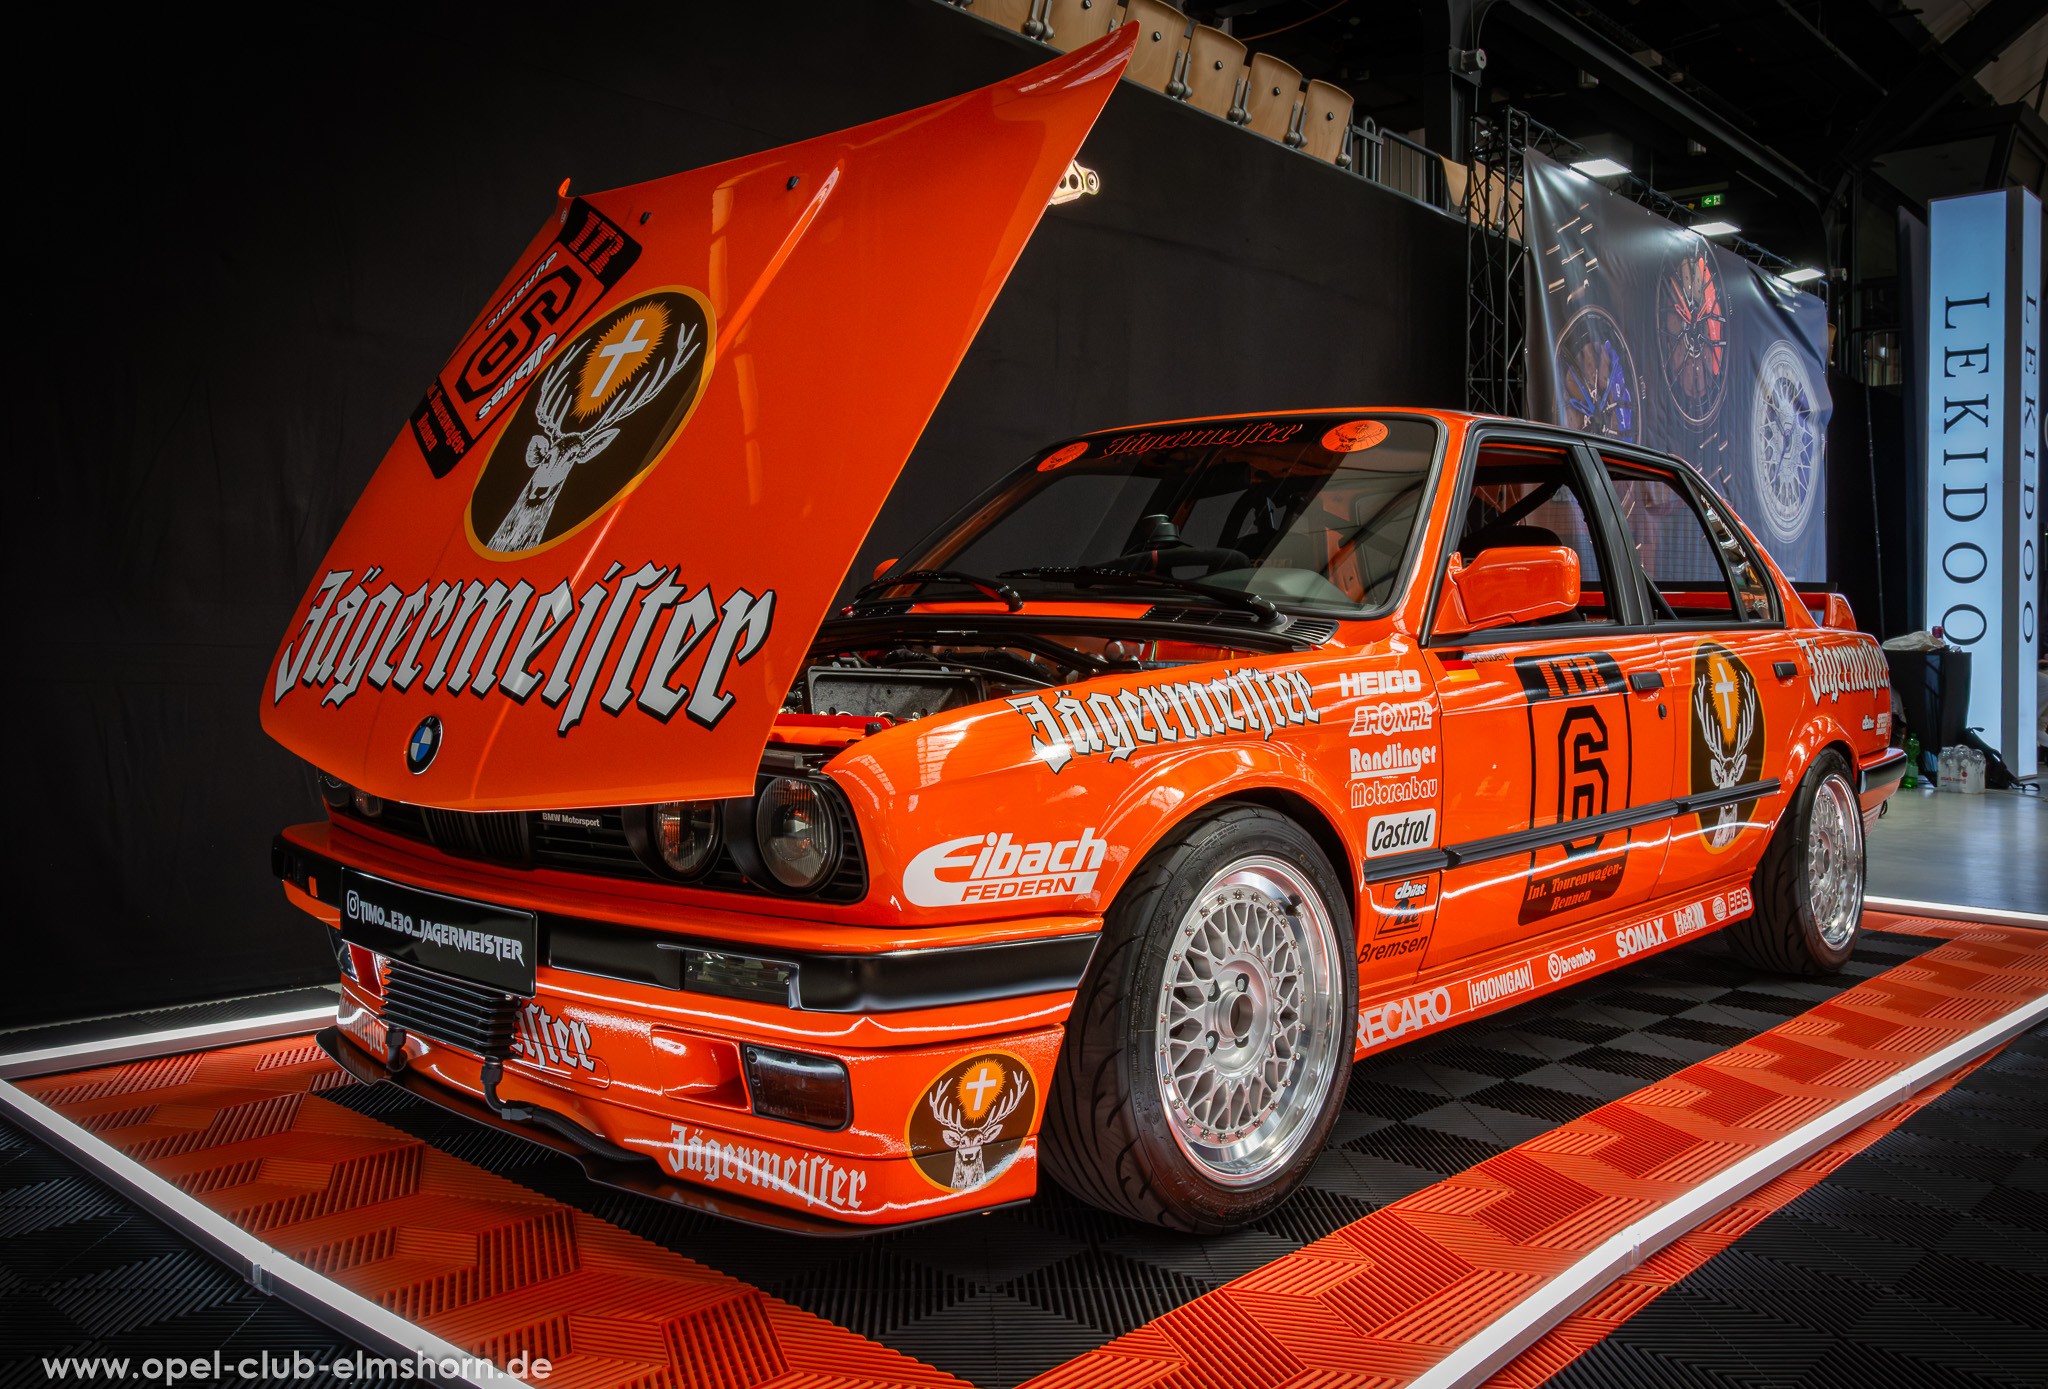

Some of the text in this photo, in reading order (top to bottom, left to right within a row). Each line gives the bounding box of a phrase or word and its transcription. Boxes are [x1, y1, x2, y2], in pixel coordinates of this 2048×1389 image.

[569, 210, 625, 276] ITR
[475, 333, 557, 421] dbilas
[1941, 292, 1991, 645] LEKIDOO
[2022, 290, 2037, 644] LEKIDOO
[274, 561, 777, 737] Jägermeister
[1339, 669, 1422, 697] HEIGO
[1535, 656, 1610, 698] ITR
[1005, 667, 1321, 774] Jägermeister
[1350, 742, 1437, 775] Randlinger
[1351, 775, 1438, 809] Motorenbau
[1558, 704, 1609, 858] 6
[541, 811, 601, 828] BMW Motorsport
[1371, 814, 1432, 851] Castrol
[902, 827, 1107, 898] Eibach
[1527, 863, 1623, 902] Int. Tourenwagen-
[961, 876, 1078, 903] FEDERN
[1551, 889, 1592, 912] Rennen
[1727, 887, 1753, 917] BBS
[359, 900, 526, 967] TIMO_E30_JAGERMEISTER
[1357, 935, 1429, 965] Bremsen
[1615, 917, 1668, 959] SONAX
[1557, 946, 1597, 977] brembo
[1356, 986, 1452, 1048] RECARO
[667, 1122, 868, 1210] Jägermeister
